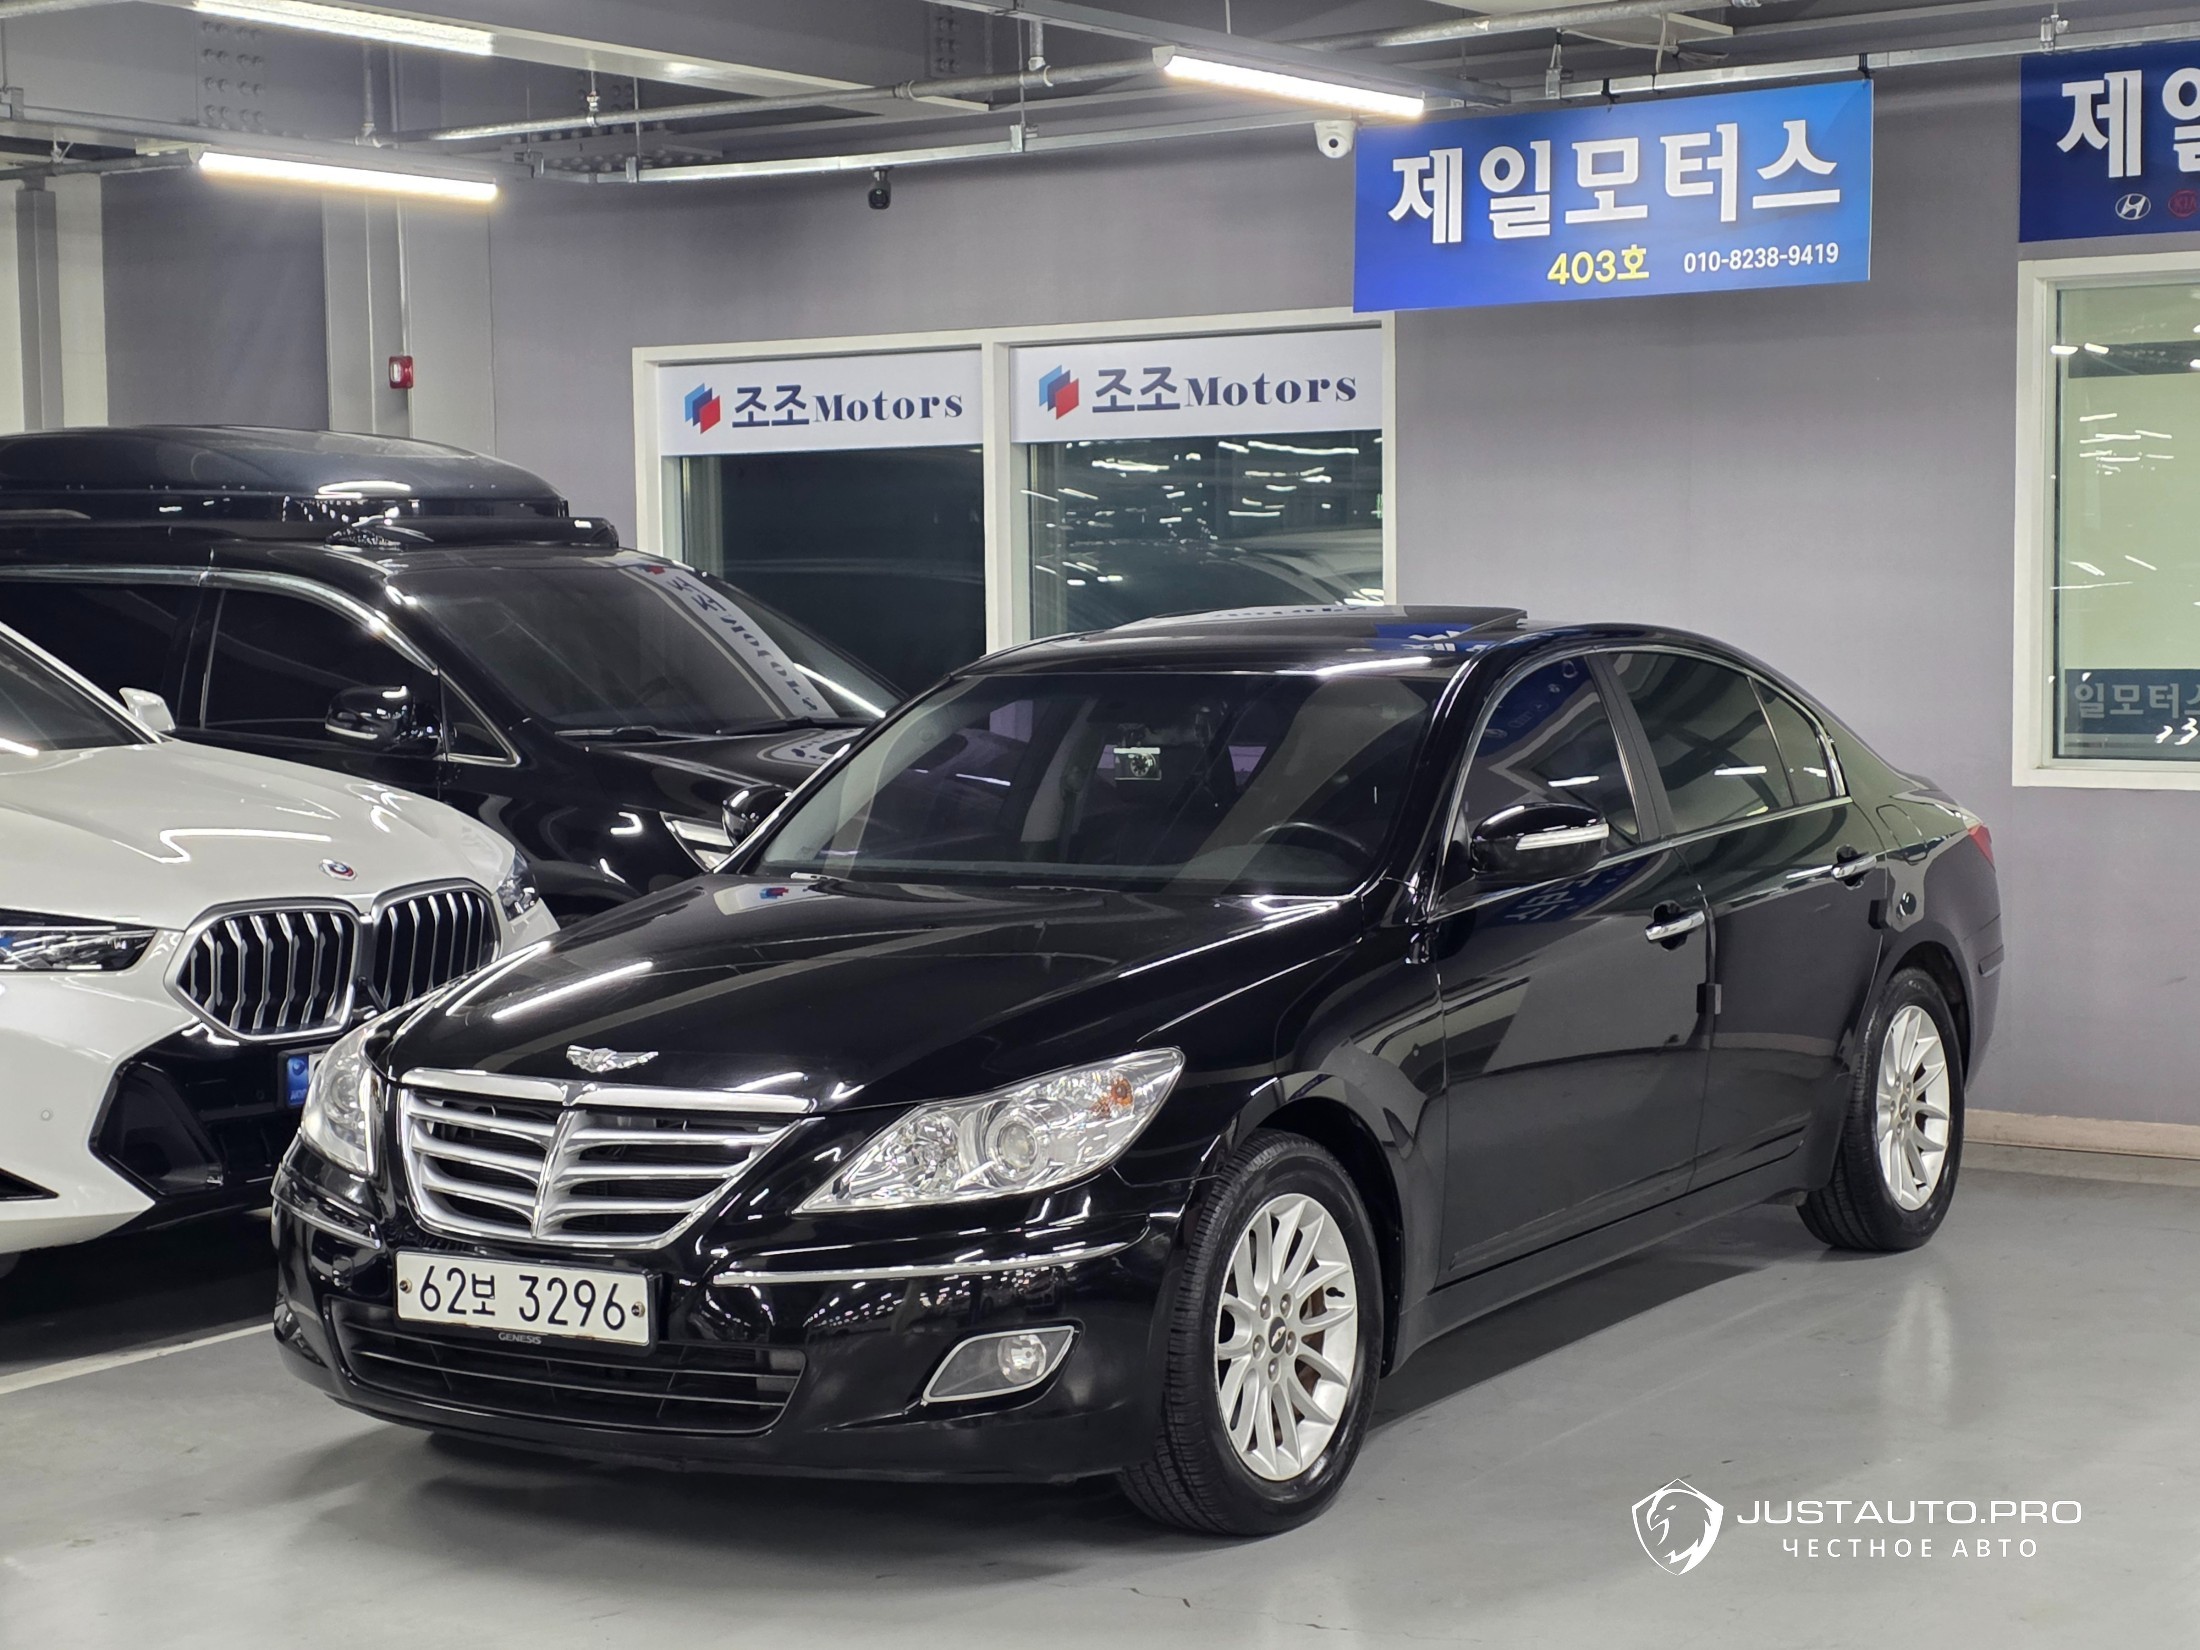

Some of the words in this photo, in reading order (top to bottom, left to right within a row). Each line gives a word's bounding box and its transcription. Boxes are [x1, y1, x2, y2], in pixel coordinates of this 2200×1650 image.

[1387, 120, 1841, 245] 제일모터스
[1546, 243, 1650, 286] 403호
[1682, 242, 1840, 275] 010-8238-9419
[418, 1264, 497, 1317] 62보
[518, 1274, 627, 1331] 3296
[497, 1332, 543, 1345] GENESIS
